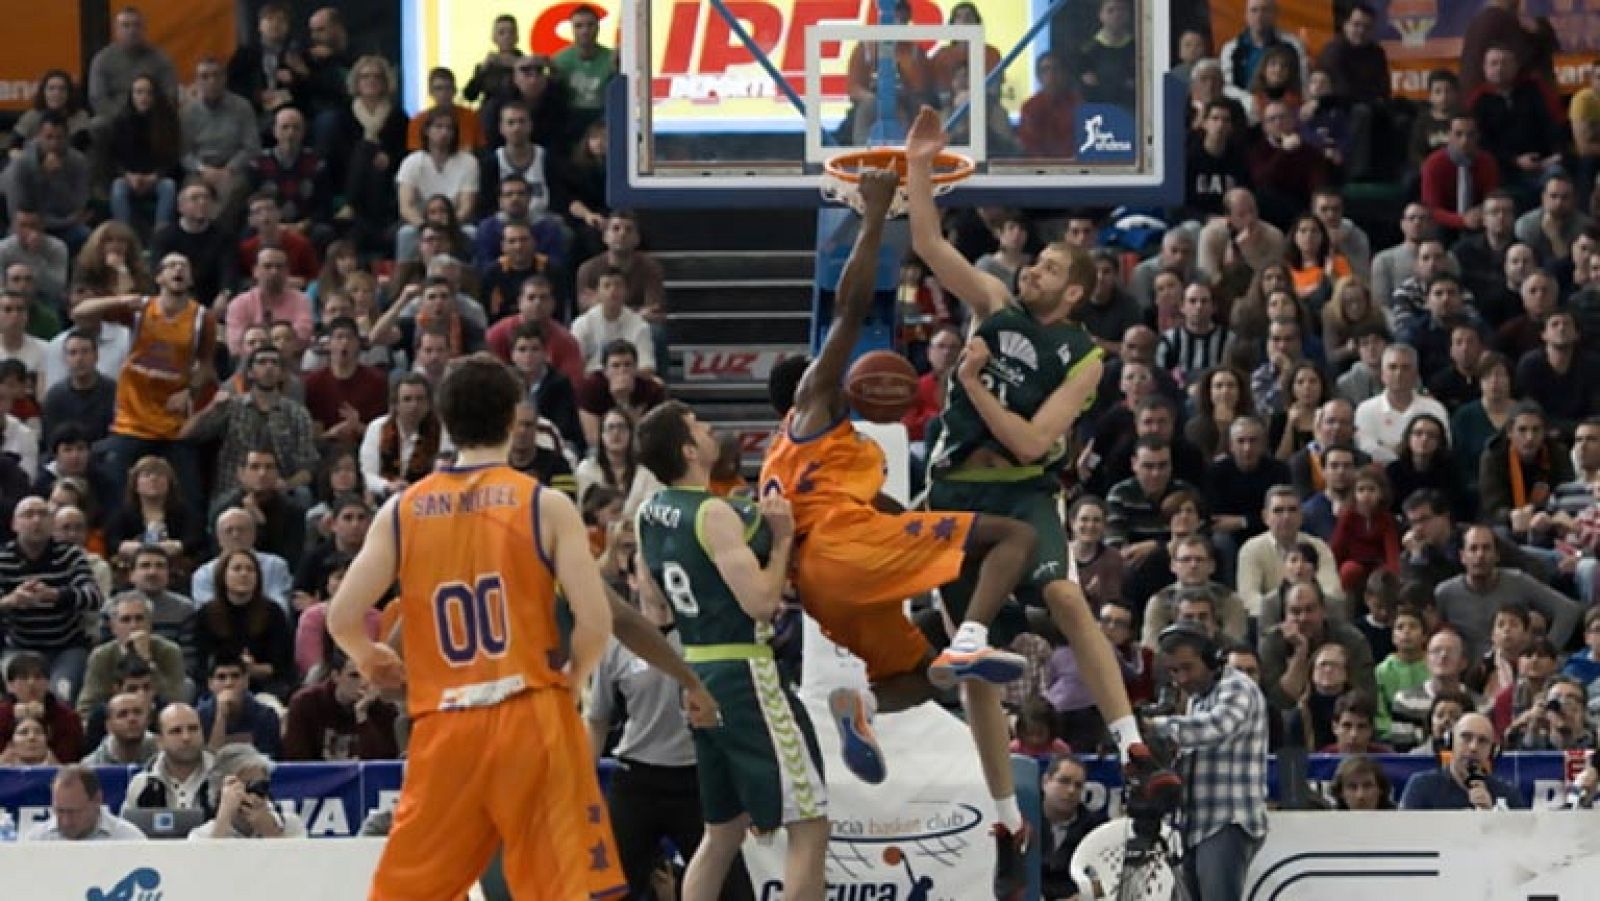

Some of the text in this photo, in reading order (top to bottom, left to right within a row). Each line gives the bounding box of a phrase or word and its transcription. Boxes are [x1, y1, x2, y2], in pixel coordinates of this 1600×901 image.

[663, 560, 699, 618] 8
[432, 571, 509, 669] 00
[926, 809, 965, 832] club
